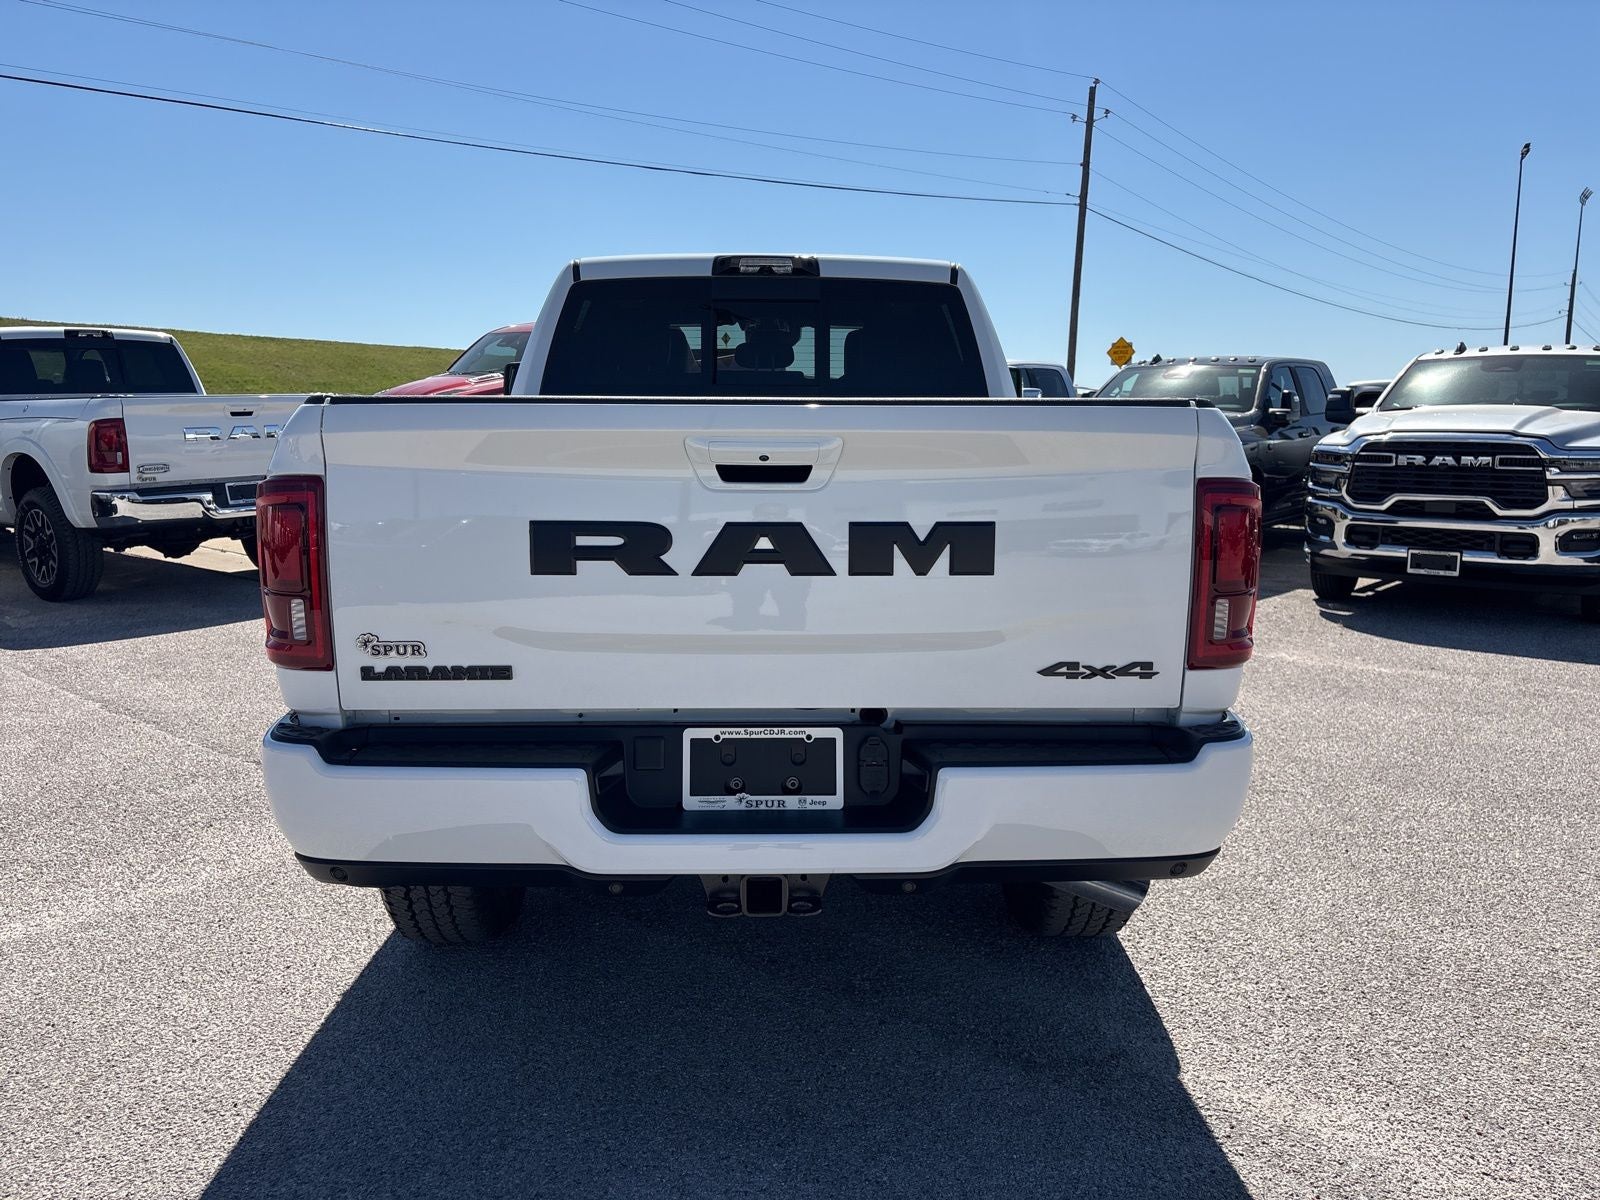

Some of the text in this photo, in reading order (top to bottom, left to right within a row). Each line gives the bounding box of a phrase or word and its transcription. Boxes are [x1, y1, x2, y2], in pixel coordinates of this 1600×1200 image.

[1397, 454, 1492, 468] RAM
[529, 520, 996, 576] RAM
[371, 644, 424, 656] SPUR
[360, 665, 513, 681] LARAMIE
[1036, 661, 1160, 680] 4x4
[720, 729, 807, 737] www.SpurCDJR.com
[745, 799, 787, 808] SPUR
